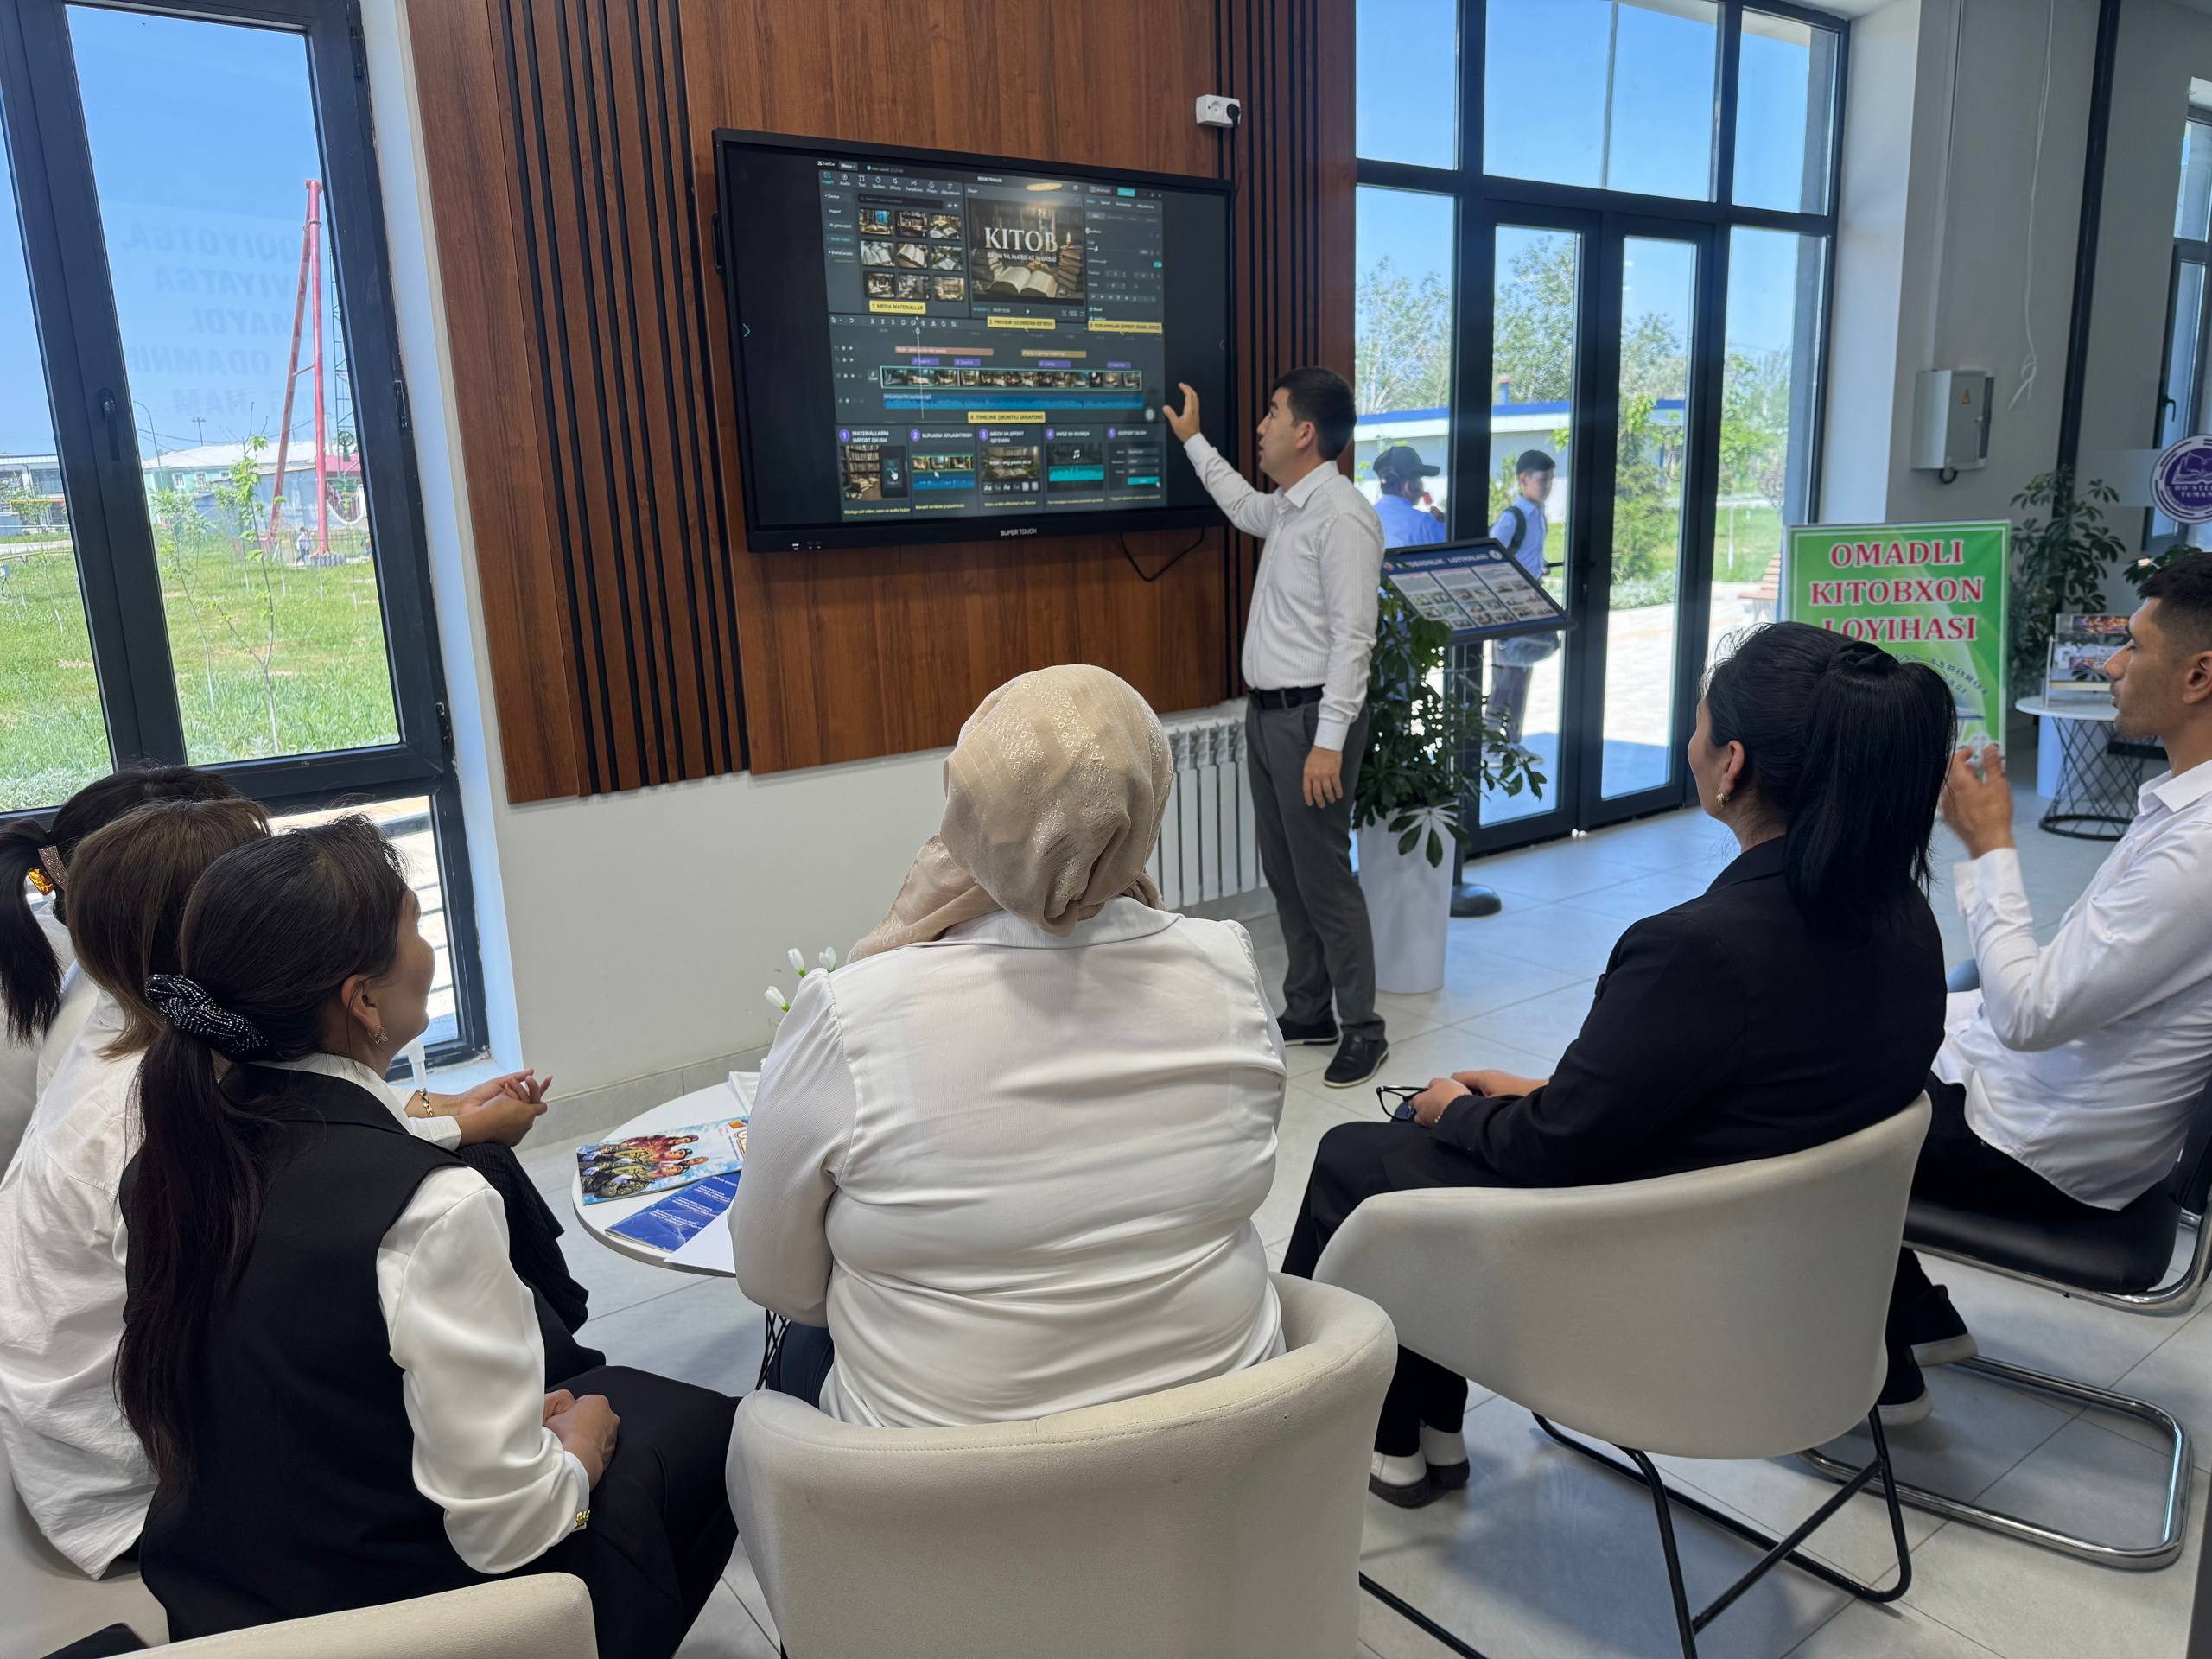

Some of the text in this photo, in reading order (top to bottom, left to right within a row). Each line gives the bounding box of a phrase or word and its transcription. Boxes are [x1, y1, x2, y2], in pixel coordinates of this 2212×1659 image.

[984, 226, 1058, 253] KITOB
[1829, 539, 1964, 568] OMADLI
[1810, 576, 1985, 606] KITOBXON
